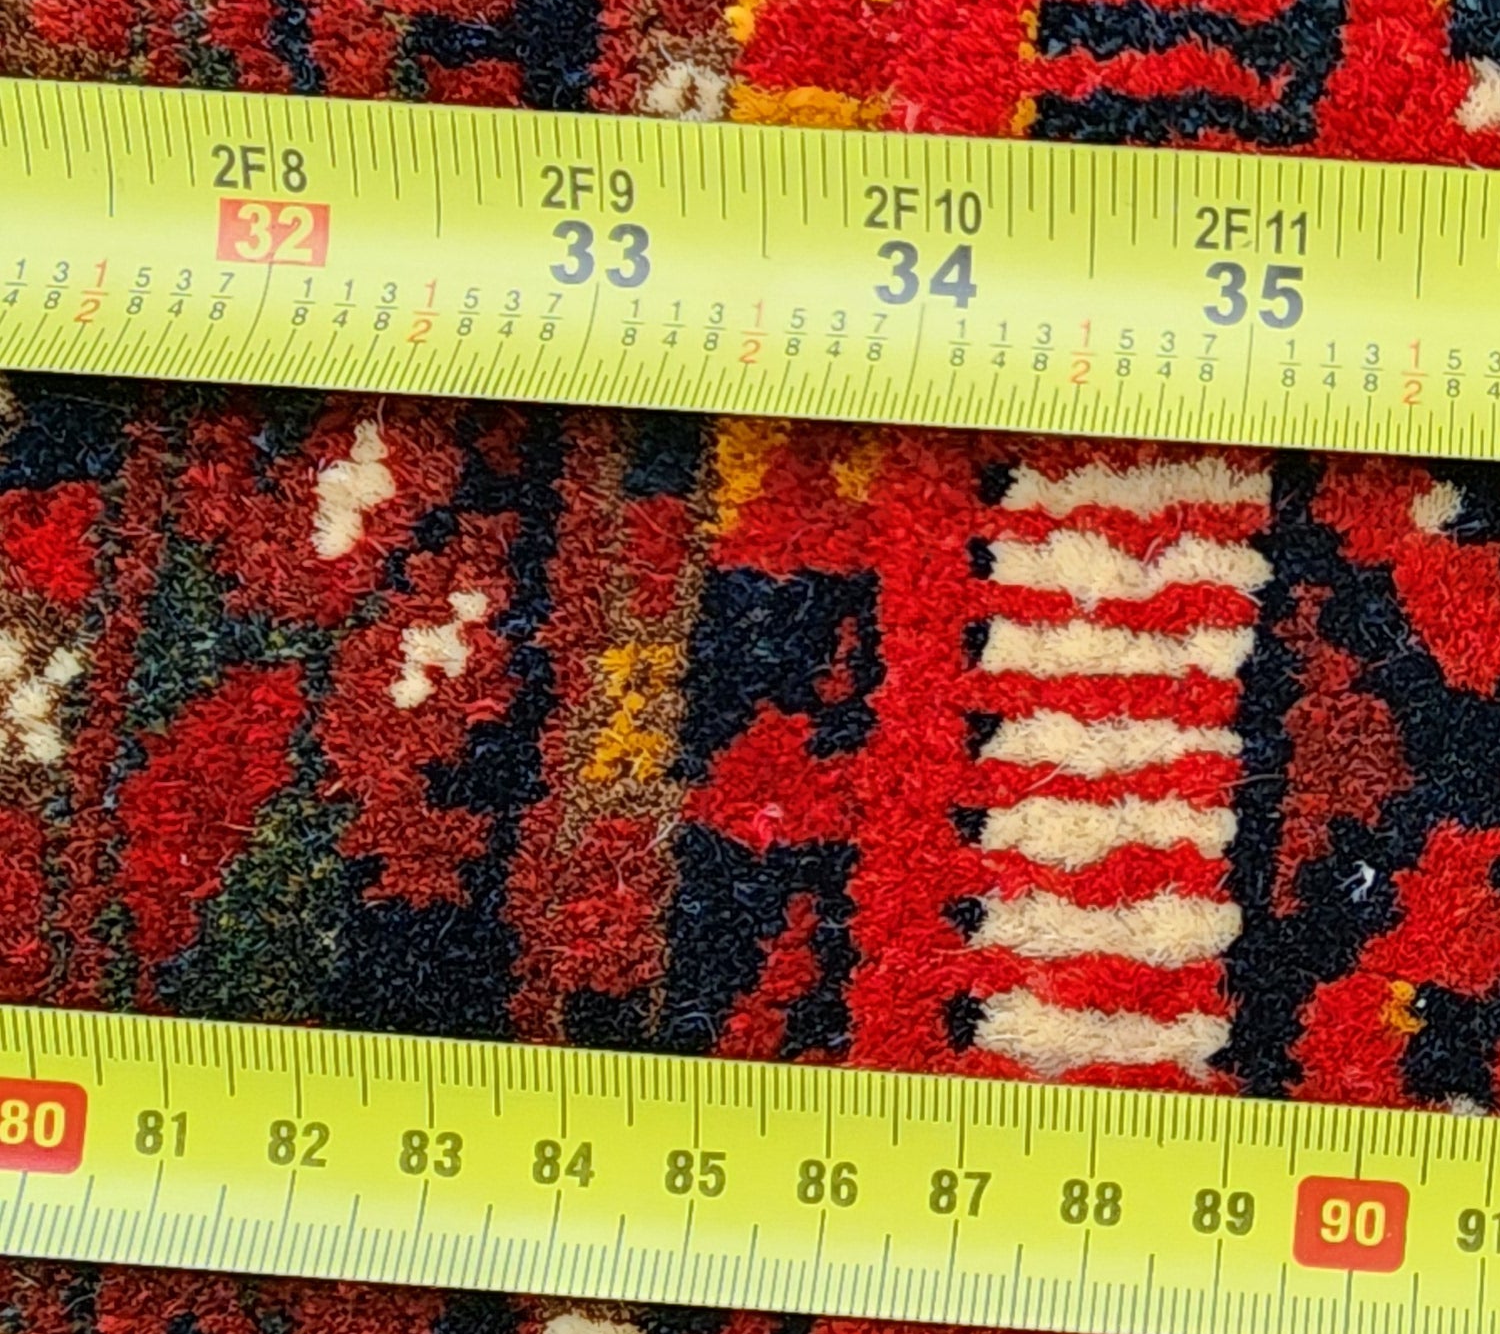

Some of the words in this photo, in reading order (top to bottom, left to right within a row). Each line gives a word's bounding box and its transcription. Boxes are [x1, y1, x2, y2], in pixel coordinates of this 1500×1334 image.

[234, 204, 313, 262] 32
[549, 220, 651, 288] 33
[875, 241, 977, 308] 34
[1204, 262, 1304, 329] 35
[0, 1099, 65, 1147] 80
[135, 1110, 188, 1157] 81
[267, 1120, 330, 1168] 82
[399, 1130, 463, 1178] 83
[532, 1140, 594, 1187] 84
[665, 1149, 726, 1196] 85
[797, 1160, 858, 1207] 86
[929, 1170, 992, 1217] 87
[1060, 1179, 1122, 1226] 88
[1192, 1189, 1255, 1235] 89
[1320, 1199, 1386, 1246] 90
